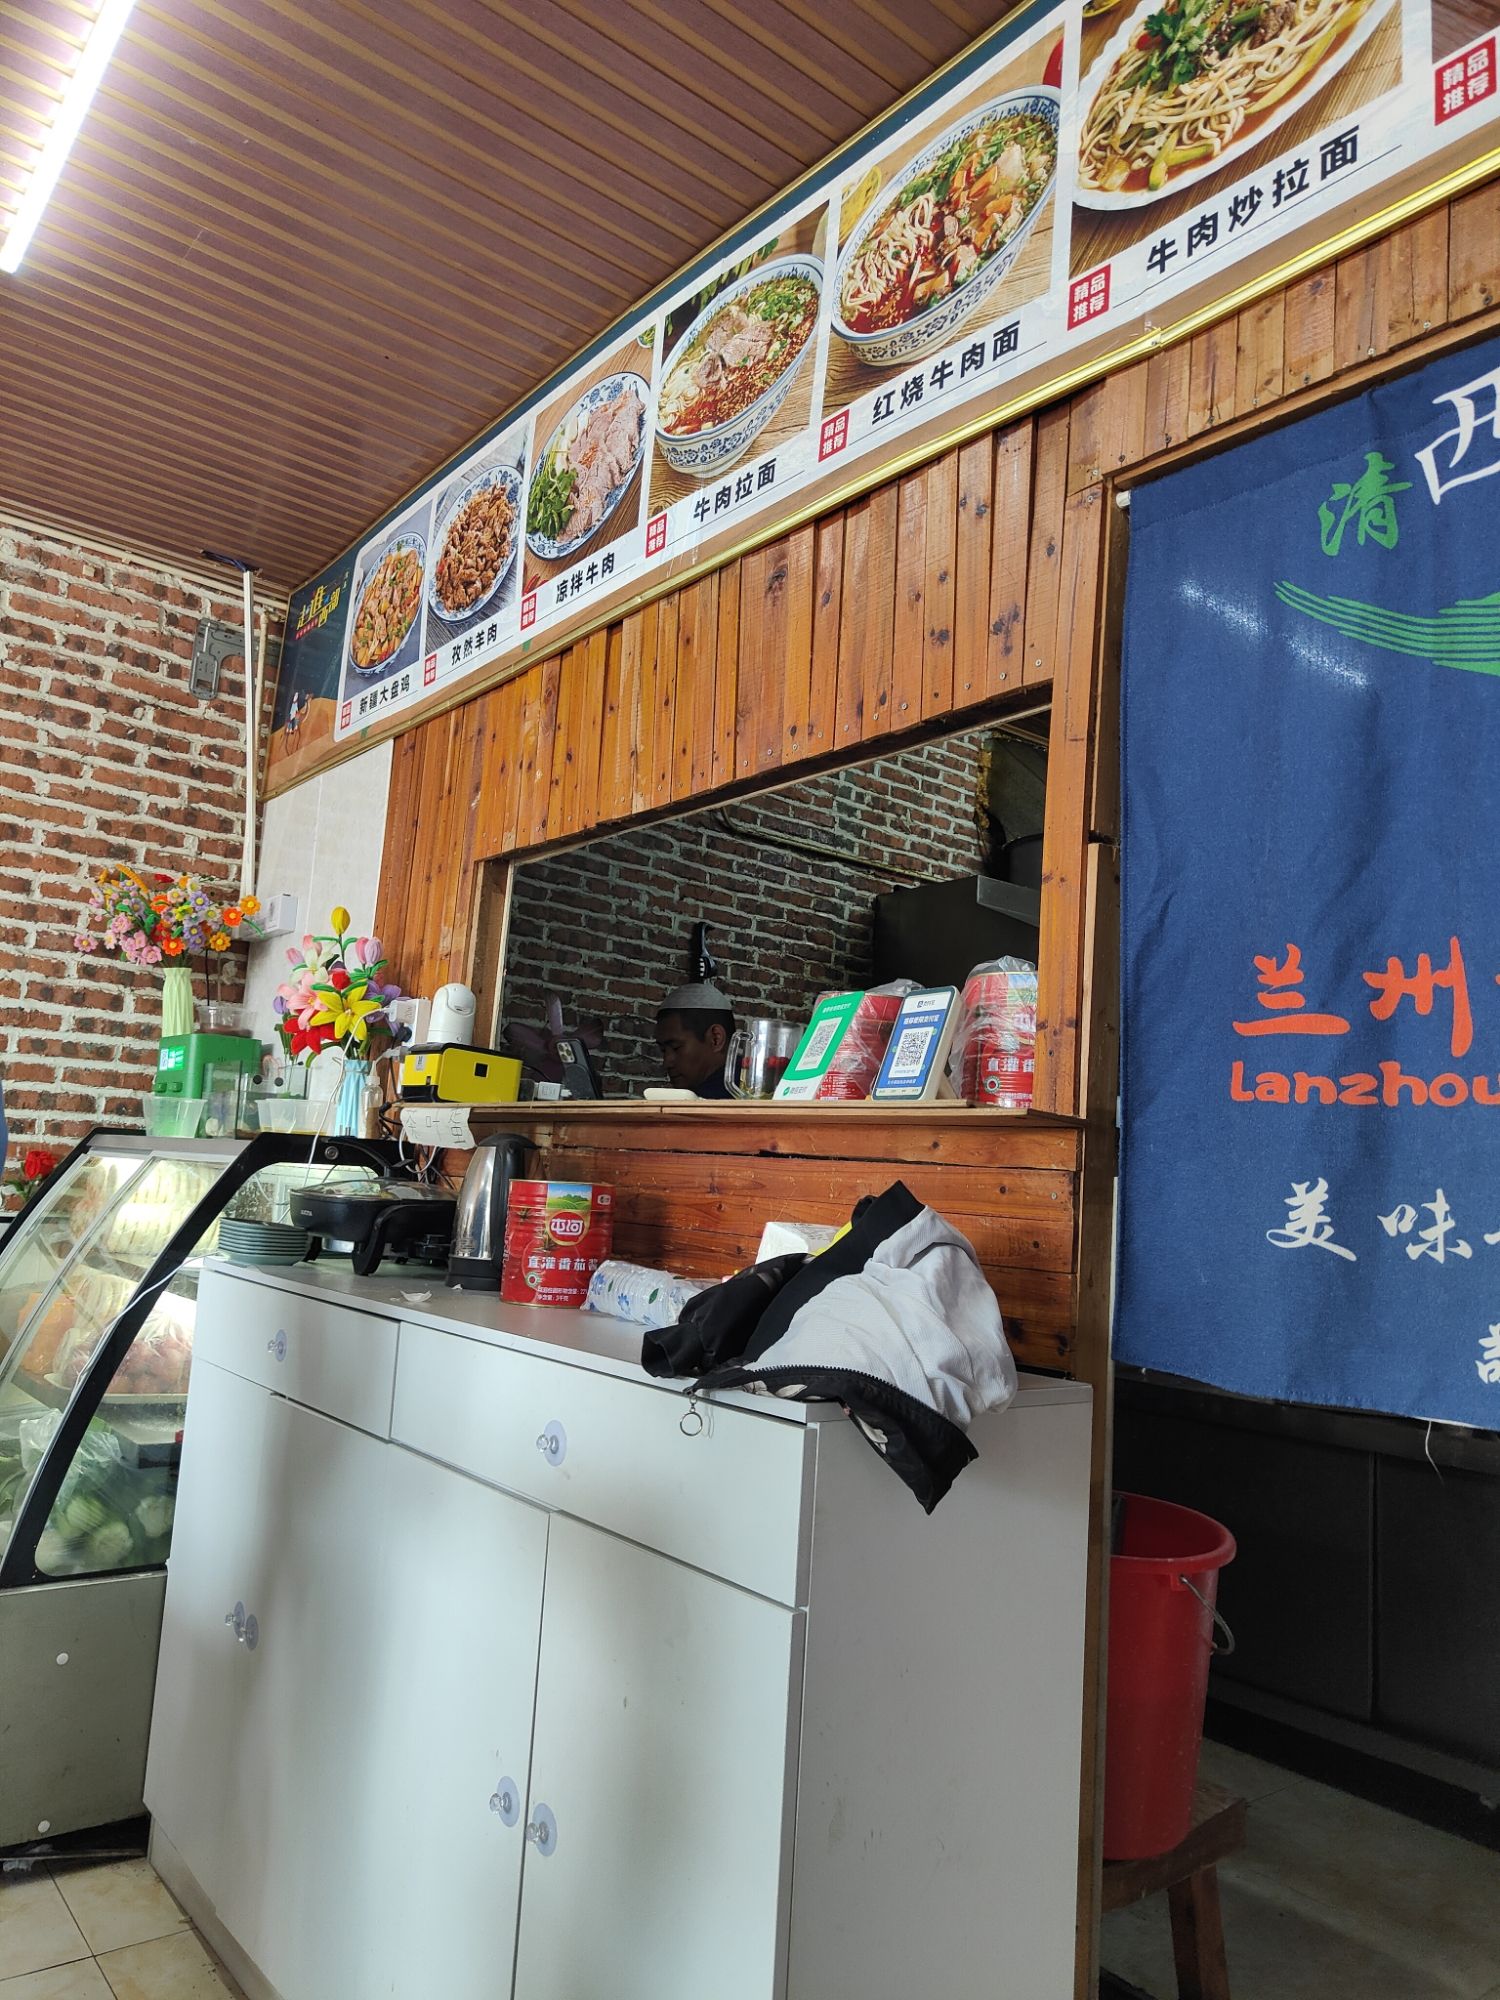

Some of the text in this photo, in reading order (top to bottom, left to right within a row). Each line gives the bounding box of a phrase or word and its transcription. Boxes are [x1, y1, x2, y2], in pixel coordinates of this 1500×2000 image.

[1443, 47, 1489, 89] 精品
[1442, 71, 1489, 111] 推荐
[1146, 125, 1359, 275] 牛肉炒拉面
[1073, 293, 1106, 323] 推荐
[1074, 272, 1106, 303] 精品
[871, 320, 1021, 425] 红烧牛肉面
[822, 432, 846, 456] 推荐
[824, 416, 846, 437] 精品
[694, 458, 777, 523] 牛肉拉面
[1317, 452, 1413, 556] 清
[556, 552, 615, 604] 凉拌牛肉
[451, 623, 497, 666] 孜然羊肉
[359, 674, 410, 715] 新疆大盘鸡
[1232, 936, 1500, 1058] 兰州
[1266, 1177, 1500, 1265] 美味
